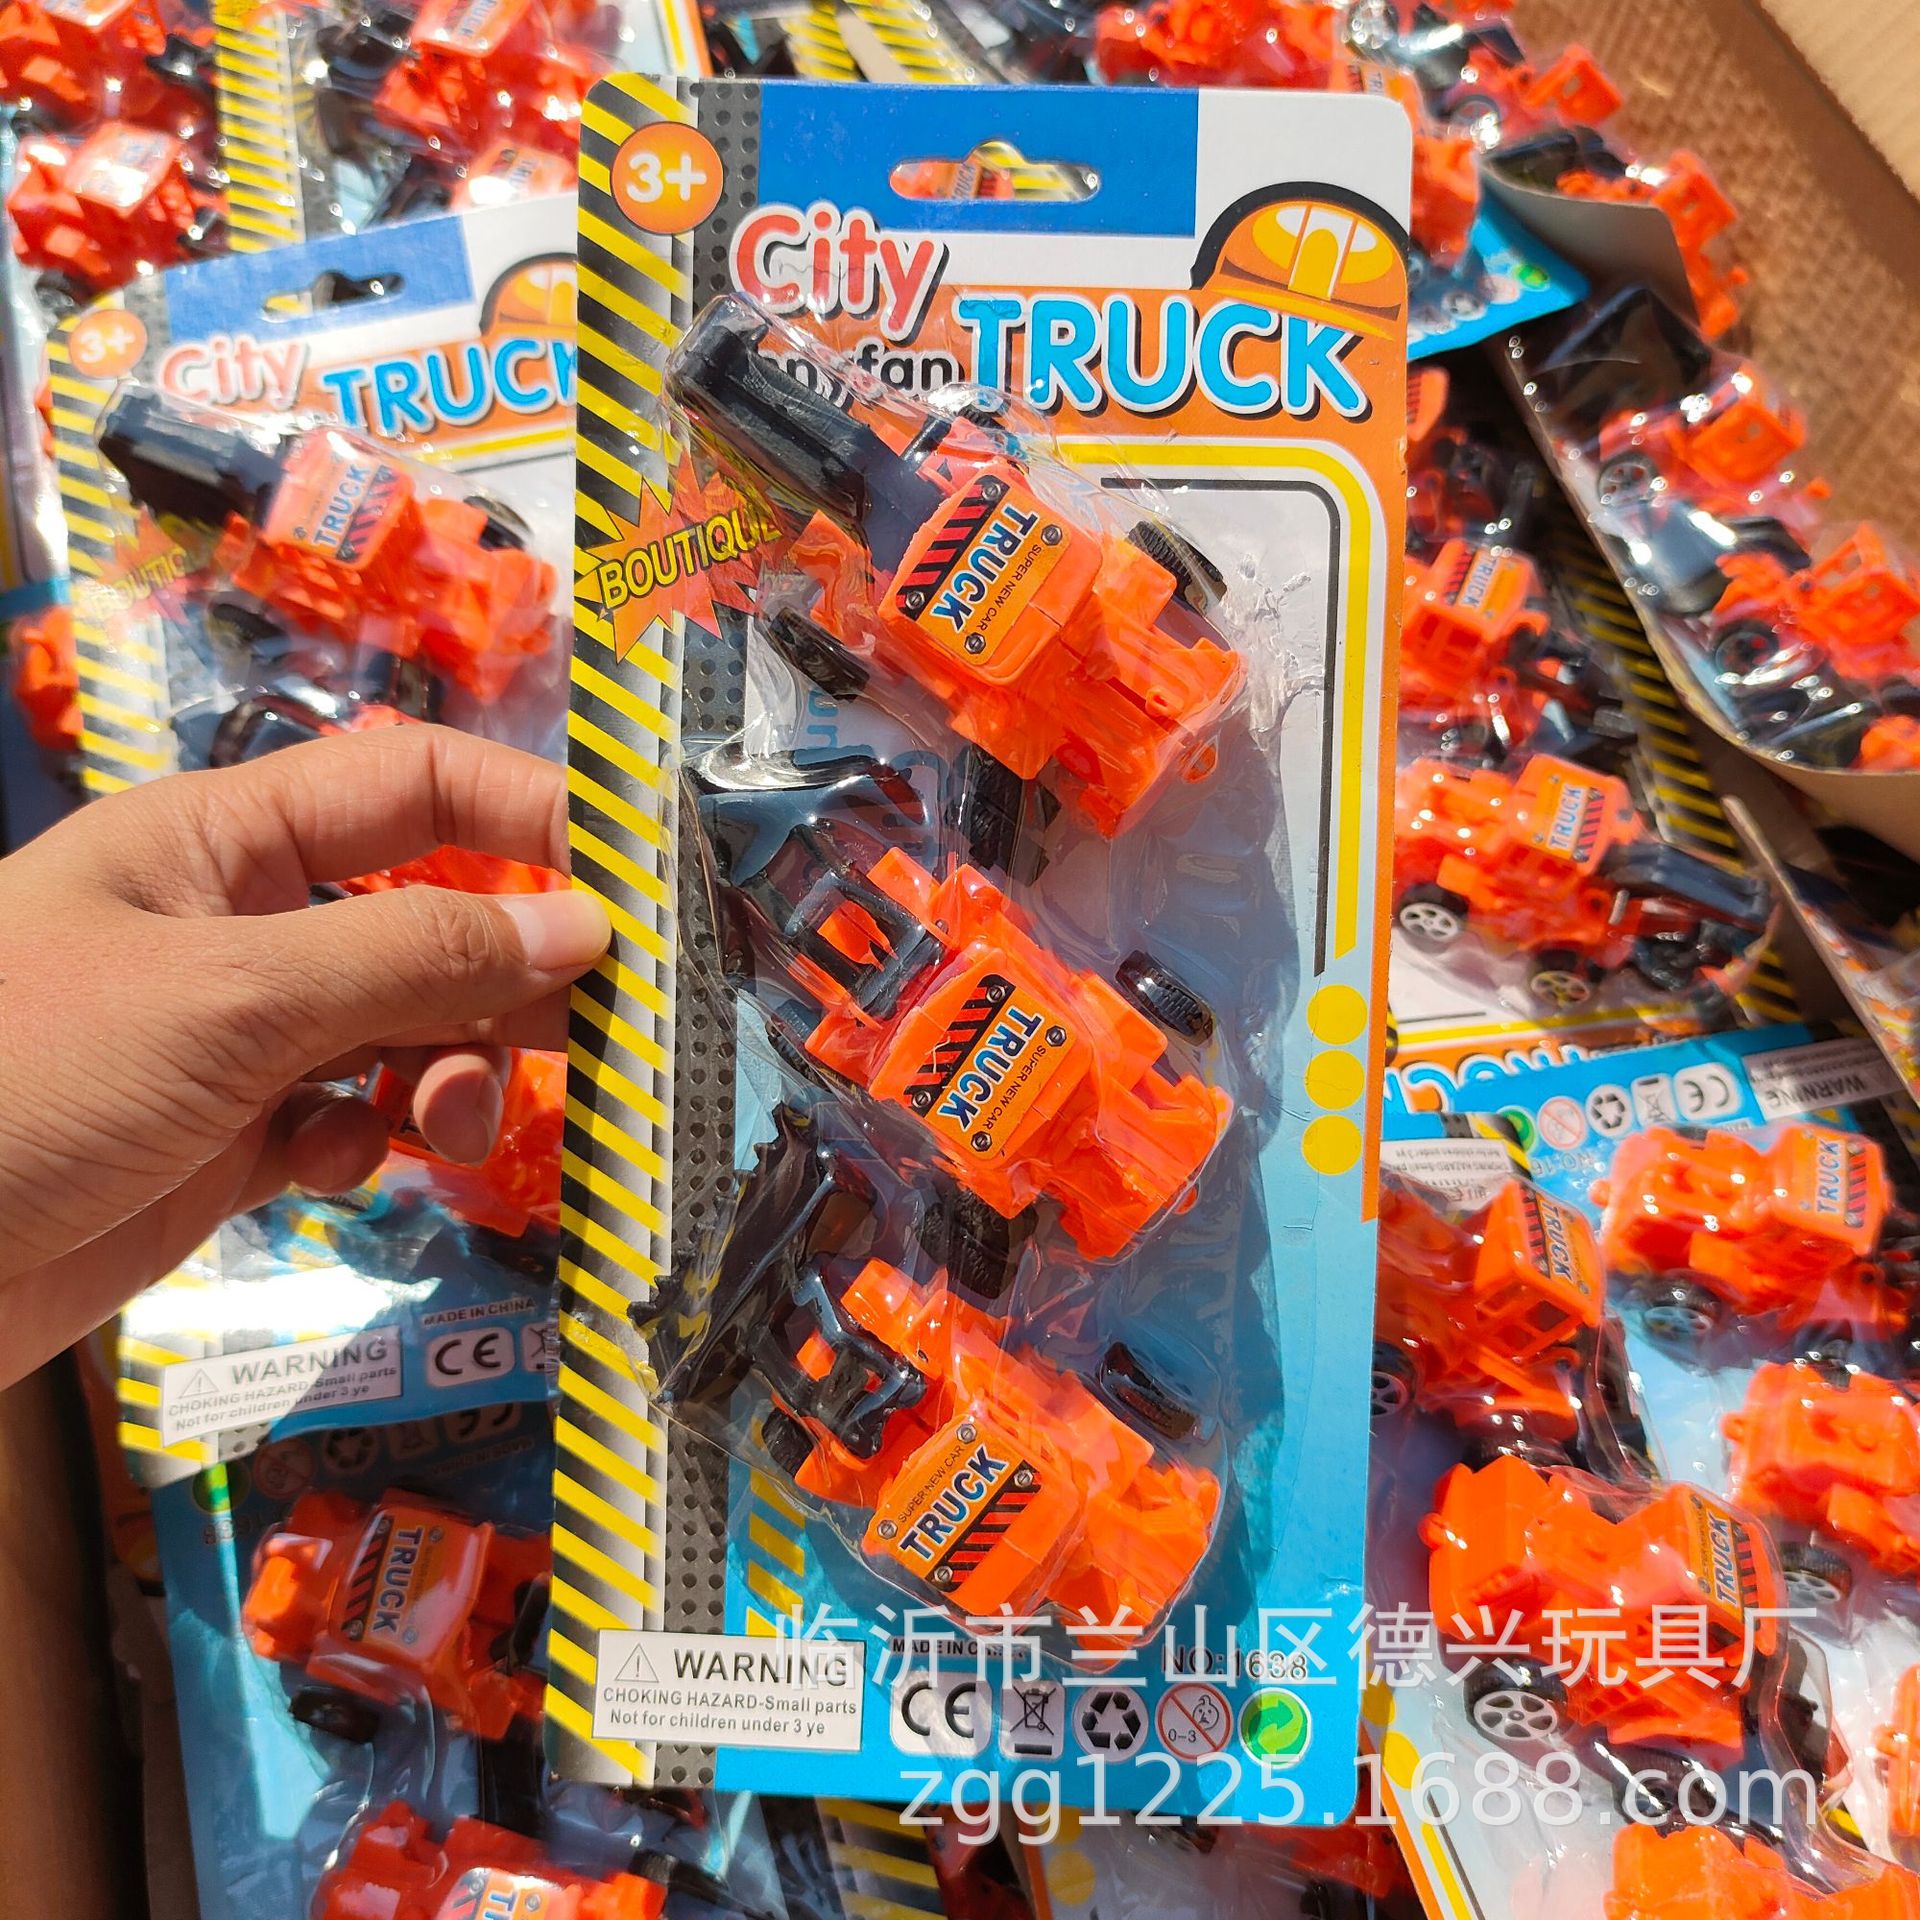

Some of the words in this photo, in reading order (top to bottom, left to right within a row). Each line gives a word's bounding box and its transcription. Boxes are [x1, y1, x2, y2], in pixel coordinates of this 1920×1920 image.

[626, 152, 707, 203] 3+
[732, 205, 942, 340] City
[79, 326, 136, 364] 3+
[954, 296, 1367, 414] TRUCK
[161, 335, 303, 408] City
[310, 463, 370, 546] TRUCK
[930, 503, 1040, 633] TRUCK
[1011, 543, 1042, 582] SUPER
[994, 579, 1017, 609] NEW
[976, 606, 997, 632] CAR
[1549, 783, 1583, 849] TRUCK
[937, 1005, 1045, 1132] TRUCK
[1016, 1045, 1047, 1082] SUPER
[999, 1080, 1022, 1108] NEW
[1683, 1075, 1730, 1113] CE
[982, 1105, 1003, 1131] CAR
[1816, 1138, 1841, 1216] TRUCK
[1541, 1201, 1574, 1282] TRUCK
[424, 1309, 467, 1326] MADE
[470, 1305, 485, 1318] IN
[488, 1298, 536, 1316] CHINA
[231, 1338, 388, 1385] WARNING
[434, 1333, 502, 1376] CE
[168, 1392, 241, 1417] CHOKING
[360, 1366, 398, 1383] parts
[176, 1416, 201, 1432] Not
[228, 1398, 291, 1418] children
[897, 1491, 928, 1523] SUPER
[924, 1468, 946, 1494] NEW
[944, 1445, 965, 1468] CAR
[898, 1443, 1009, 1562] TRUCK
[372, 1525, 424, 1634] TRUCK
[1707, 1510, 1739, 1607] TRUCK
[673, 1648, 848, 1687] WARNING
[947, 1641, 964, 1655] IN
[603, 1687, 682, 1706] CHOKING
[814, 1699, 857, 1716] parts
[610, 1708, 638, 1725] Not
[642, 1711, 665, 1726] for
[669, 1711, 737, 1730] children
[742, 1715, 789, 1733] under
[793, 1718, 802, 1732] 3
[806, 1721, 825, 1737] ye
[901, 1680, 978, 1739] CE
[1167, 1729, 1197, 1744] 0-3
